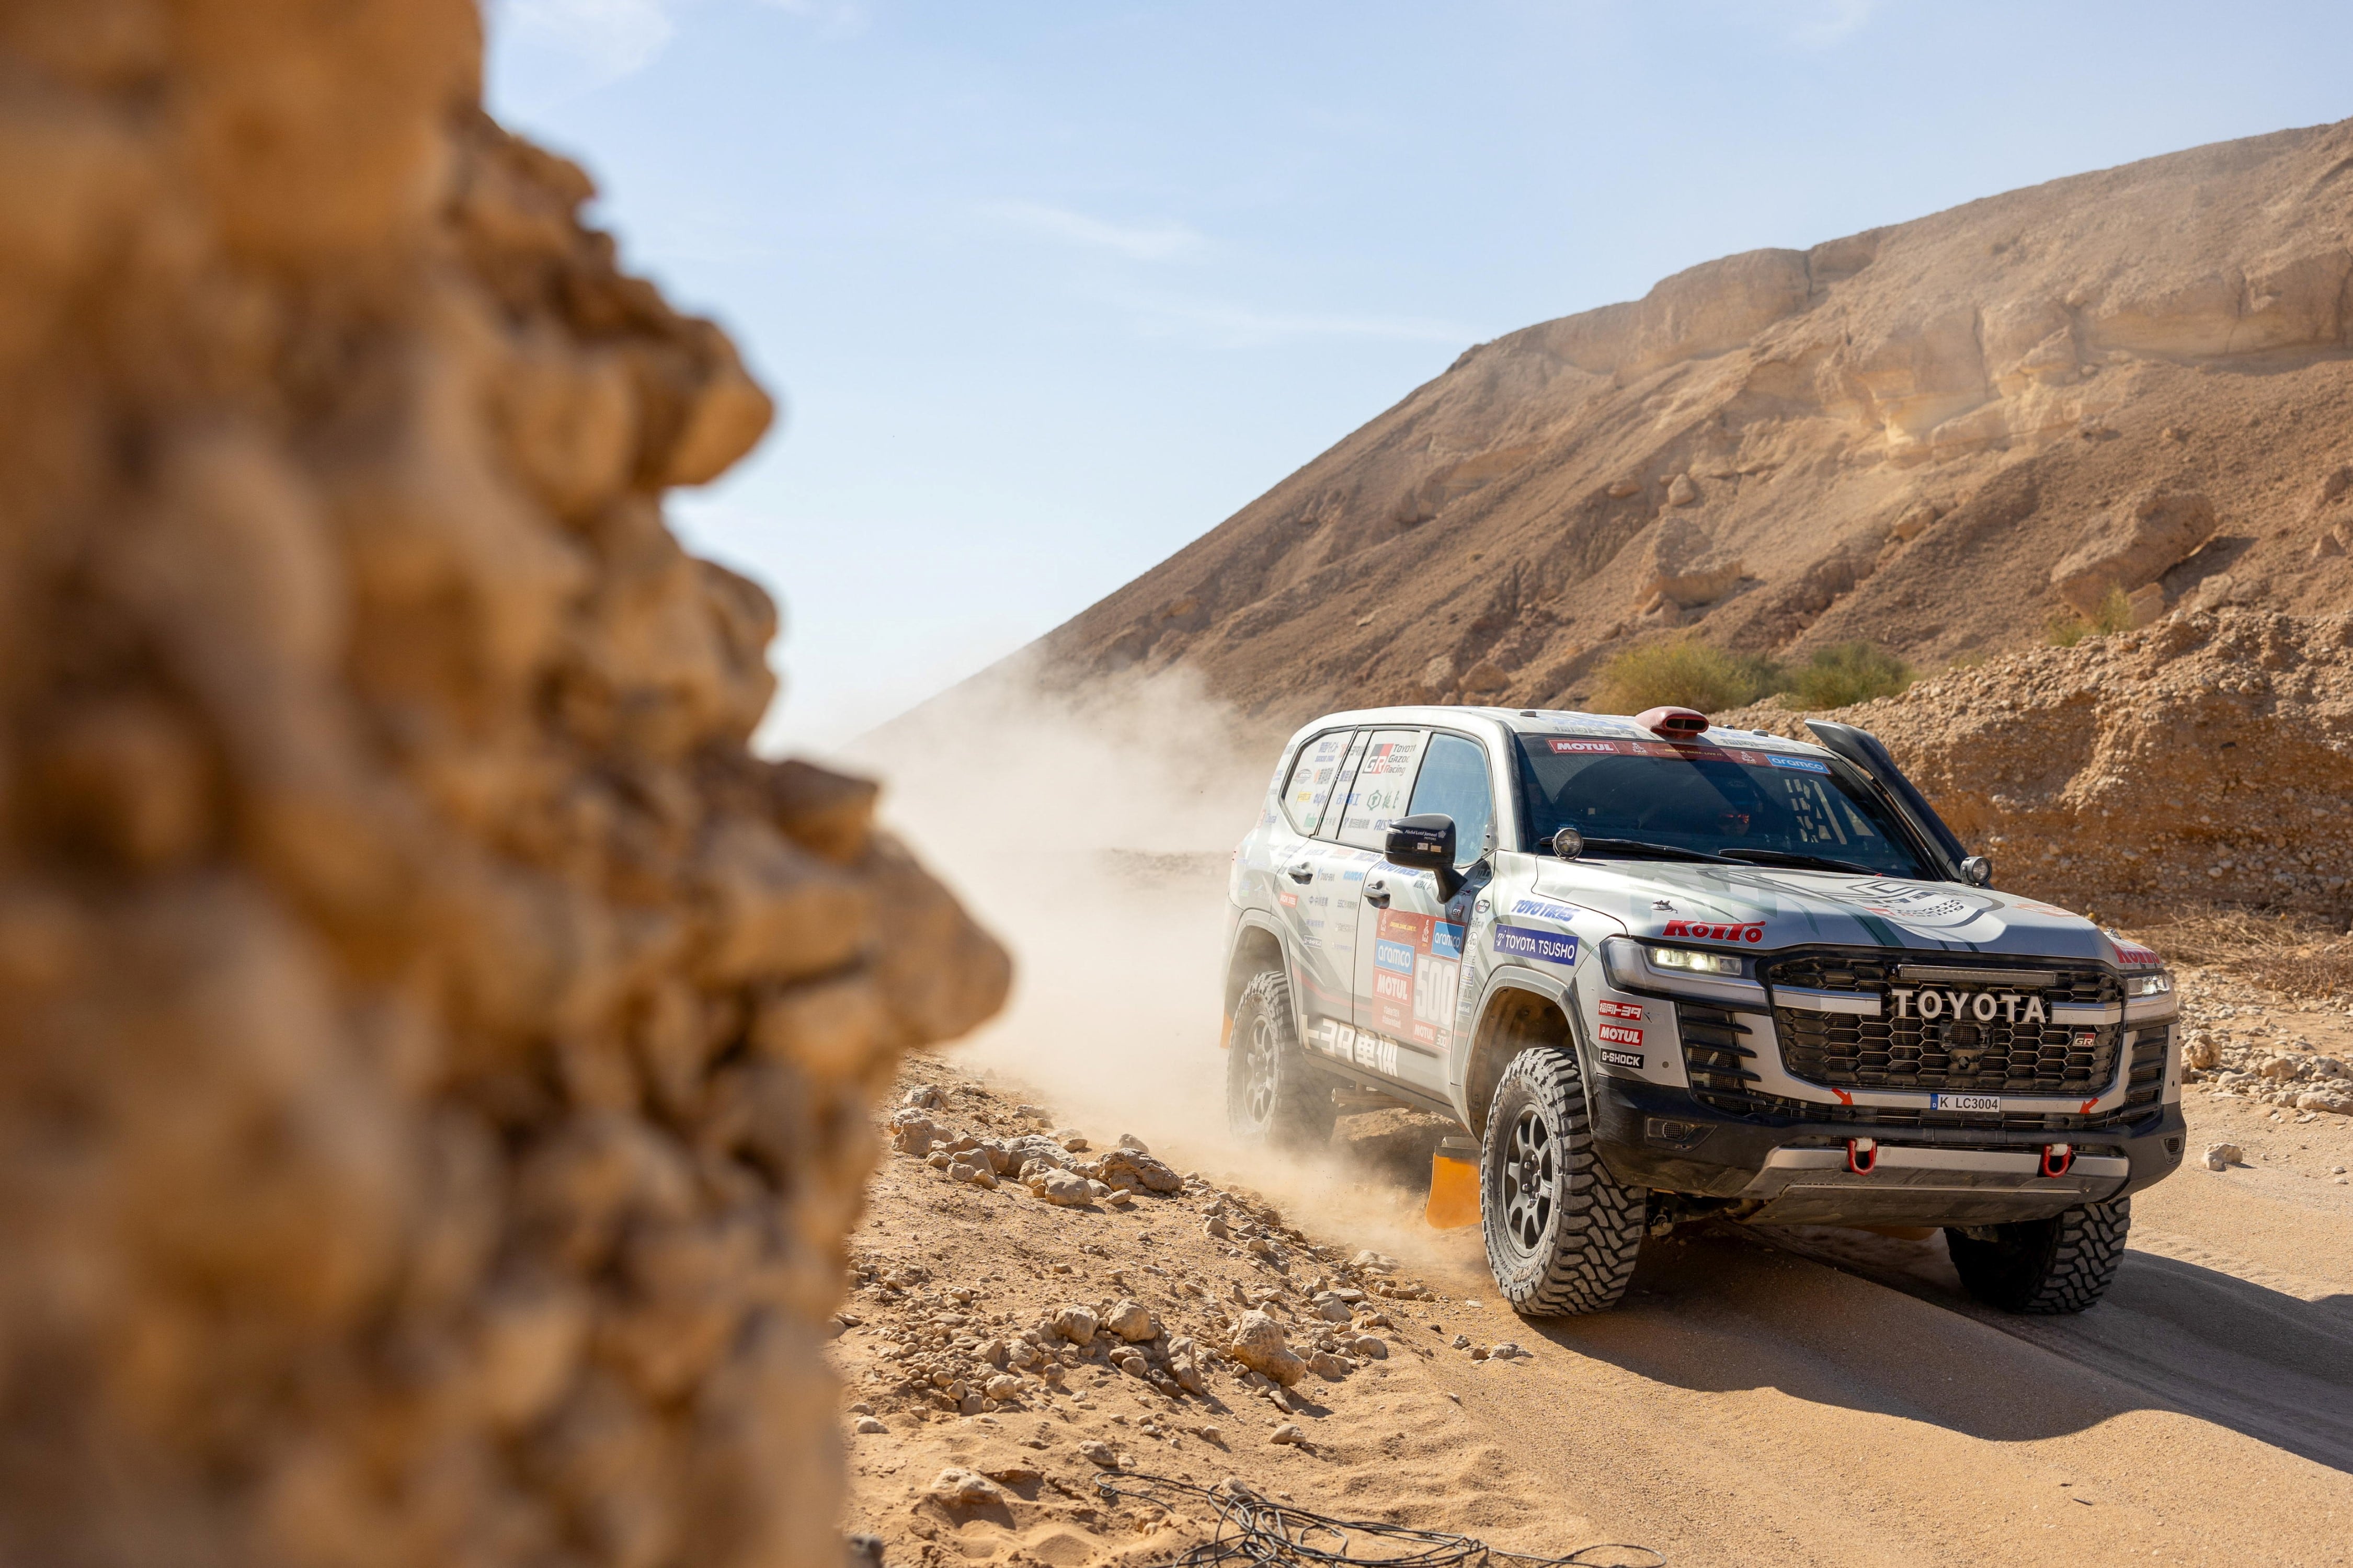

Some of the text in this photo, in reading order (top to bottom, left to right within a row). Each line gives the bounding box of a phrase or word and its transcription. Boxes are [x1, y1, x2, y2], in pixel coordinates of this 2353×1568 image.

[1364, 756, 1387, 774] GR
[1383, 765, 1406, 776] Racing
[1772, 758, 1824, 770] aramco
[1511, 899, 1545, 916] TOYO
[1539, 903, 1581, 922] TIRES
[1434, 932, 1460, 948] aramco
[1505, 934, 1575, 959] TOYOTA TSUSHO
[1378, 945, 1411, 967] aramco
[1376, 974, 1408, 1000] MOTUL
[1415, 958, 1456, 1026] 500
[1599, 1002, 1642, 1018] 福岡トヨタ
[1891, 988, 2046, 1023] TOYOTA
[1414, 1024, 1434, 1040] MOTUL
[1600, 1026, 1640, 1044] MOTUL
[1301, 1014, 1398, 1078] トヨタ車体
[1602, 1051, 1640, 1067] G-SHOCK
[1940, 1097, 1949, 1108] K
[1956, 1097, 1998, 1109] LC3004
